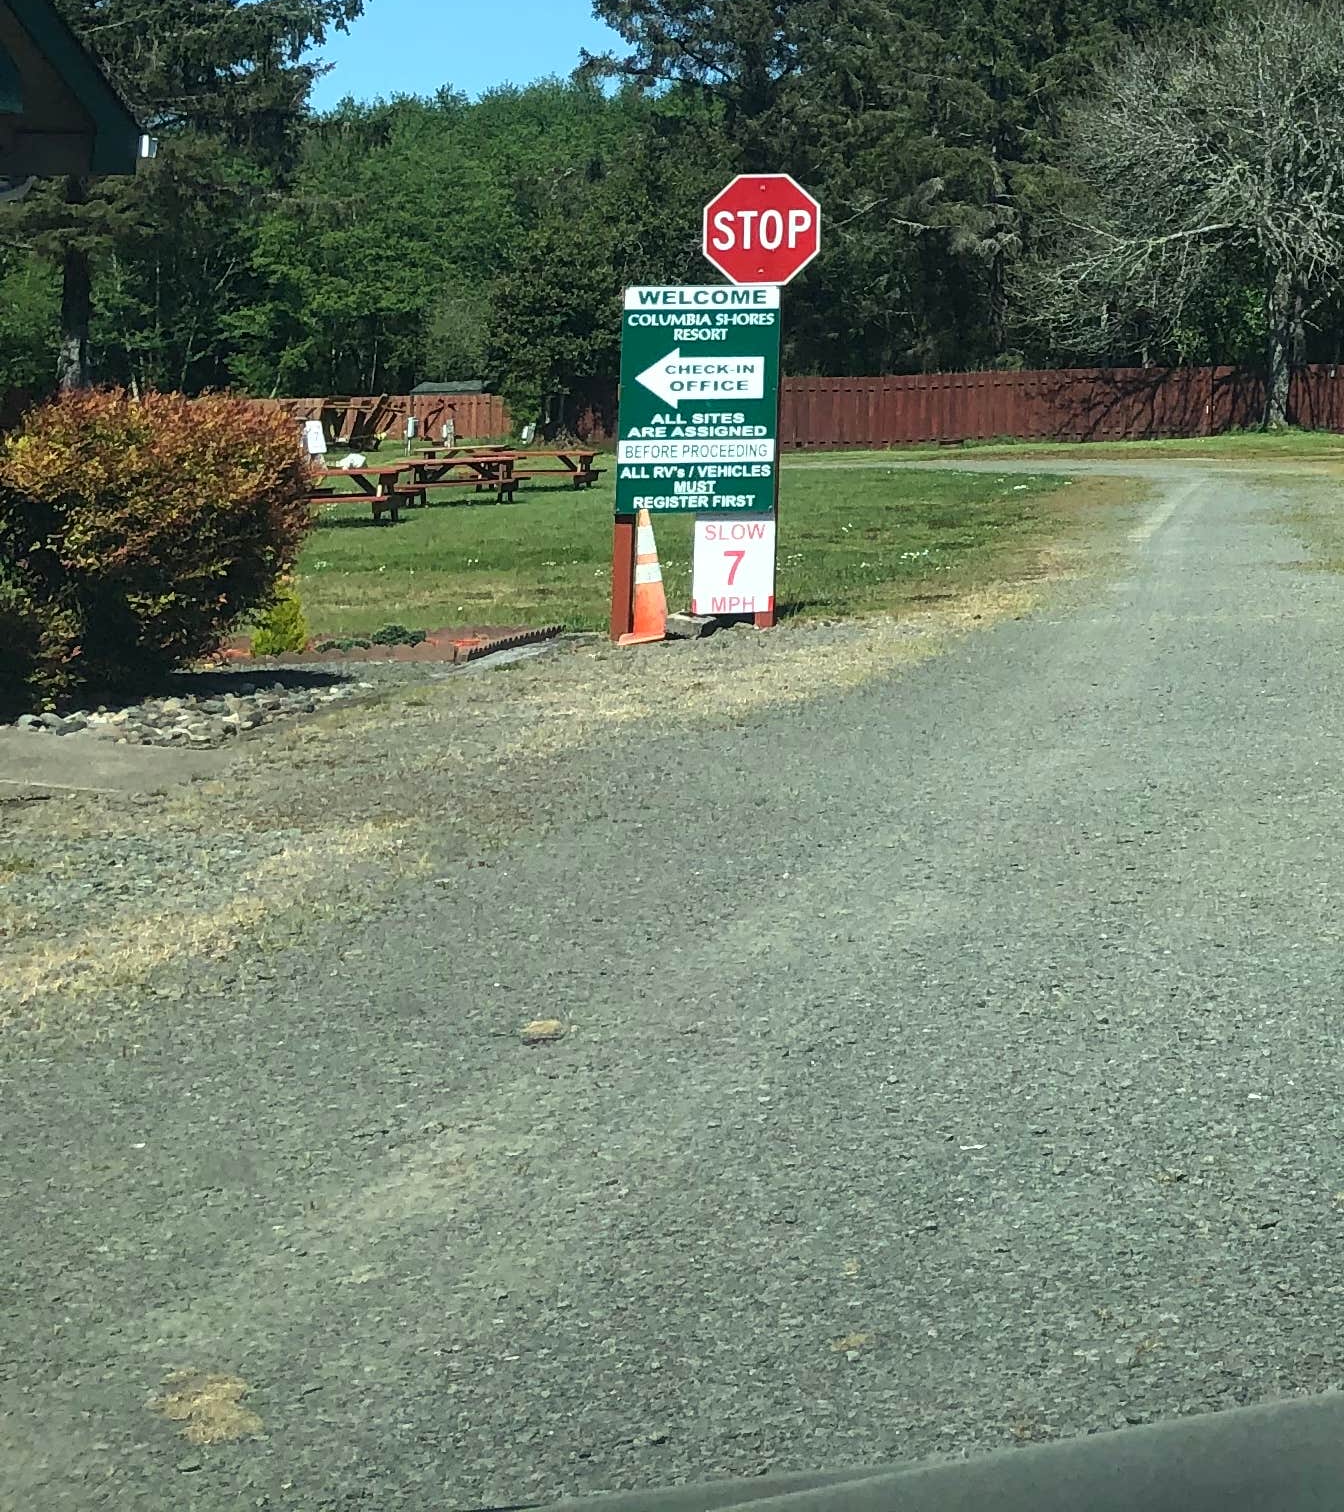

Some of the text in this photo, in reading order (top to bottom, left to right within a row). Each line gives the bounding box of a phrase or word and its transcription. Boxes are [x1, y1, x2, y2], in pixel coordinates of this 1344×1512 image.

[712, 209, 812, 251] STOP
[638, 289, 767, 305] WELCOME
[627, 313, 775, 327] COLUMBIA SHORES
[673, 328, 728, 341] RESORT
[664, 364, 755, 375] CHECK-IN
[669, 380, 749, 392] OFFICE
[650, 412, 745, 425] ALL SITES
[627, 425, 768, 438] ARE ASSIGNED
[625, 444, 768, 459] BEFORE PROCEEDING
[620, 466, 650, 479] ALL
[653, 466, 685, 478] RV's
[697, 464, 771, 478] VEHICLES
[673, 480, 716, 494] MUST
[632, 494, 756, 509] REGISTER FIRST
[704, 523, 767, 540] SLOW
[723, 550, 746, 586] 7
[711, 596, 756, 612] MPH
